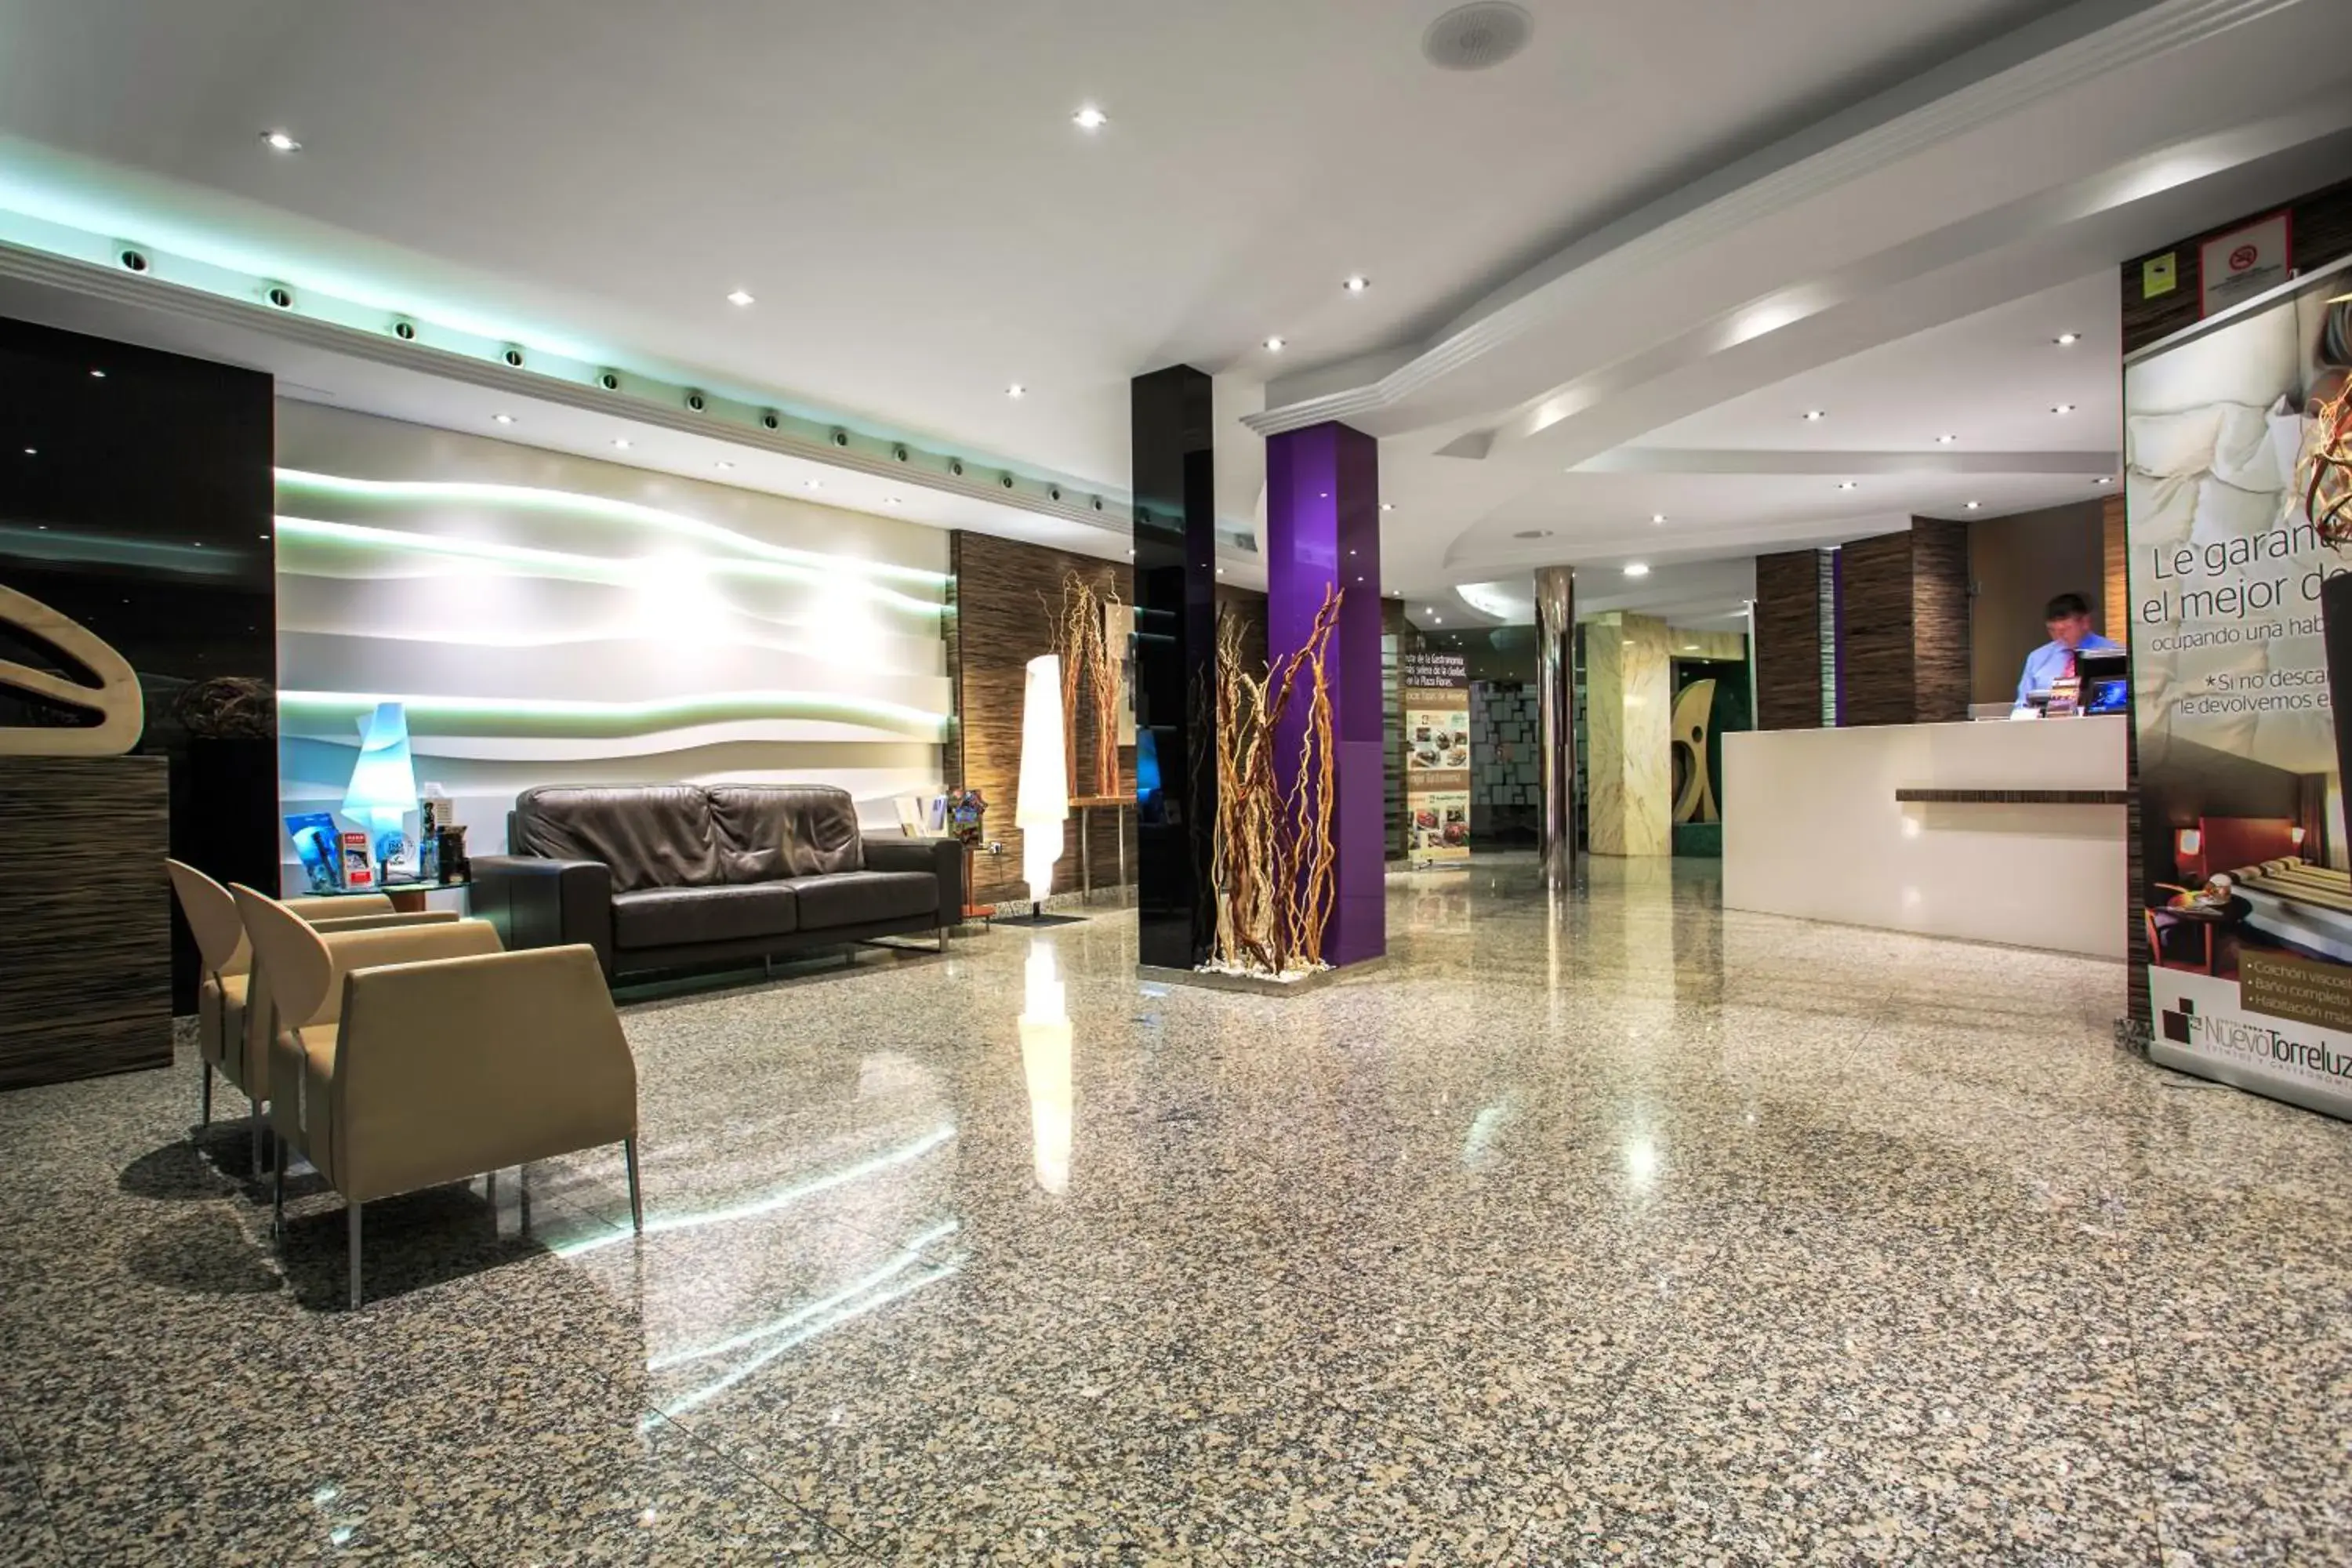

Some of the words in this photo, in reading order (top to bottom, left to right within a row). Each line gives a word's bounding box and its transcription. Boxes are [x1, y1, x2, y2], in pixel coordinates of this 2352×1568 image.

[2154, 548, 2194, 580] Le
[2143, 590, 2169, 624] el
[2180, 576, 2288, 619] mejor
[2151, 626, 2241, 652] ocupando
[2246, 619, 2283, 641] una
[2239, 673, 2265, 690] no
[2180, 699, 2194, 715] le
[2198, 692, 2313, 714] devolvemos
[2253, 960, 2307, 982] Colchón
[2256, 993, 2321, 1018] Habitación
[2289, 985, 2350, 1006] completo
